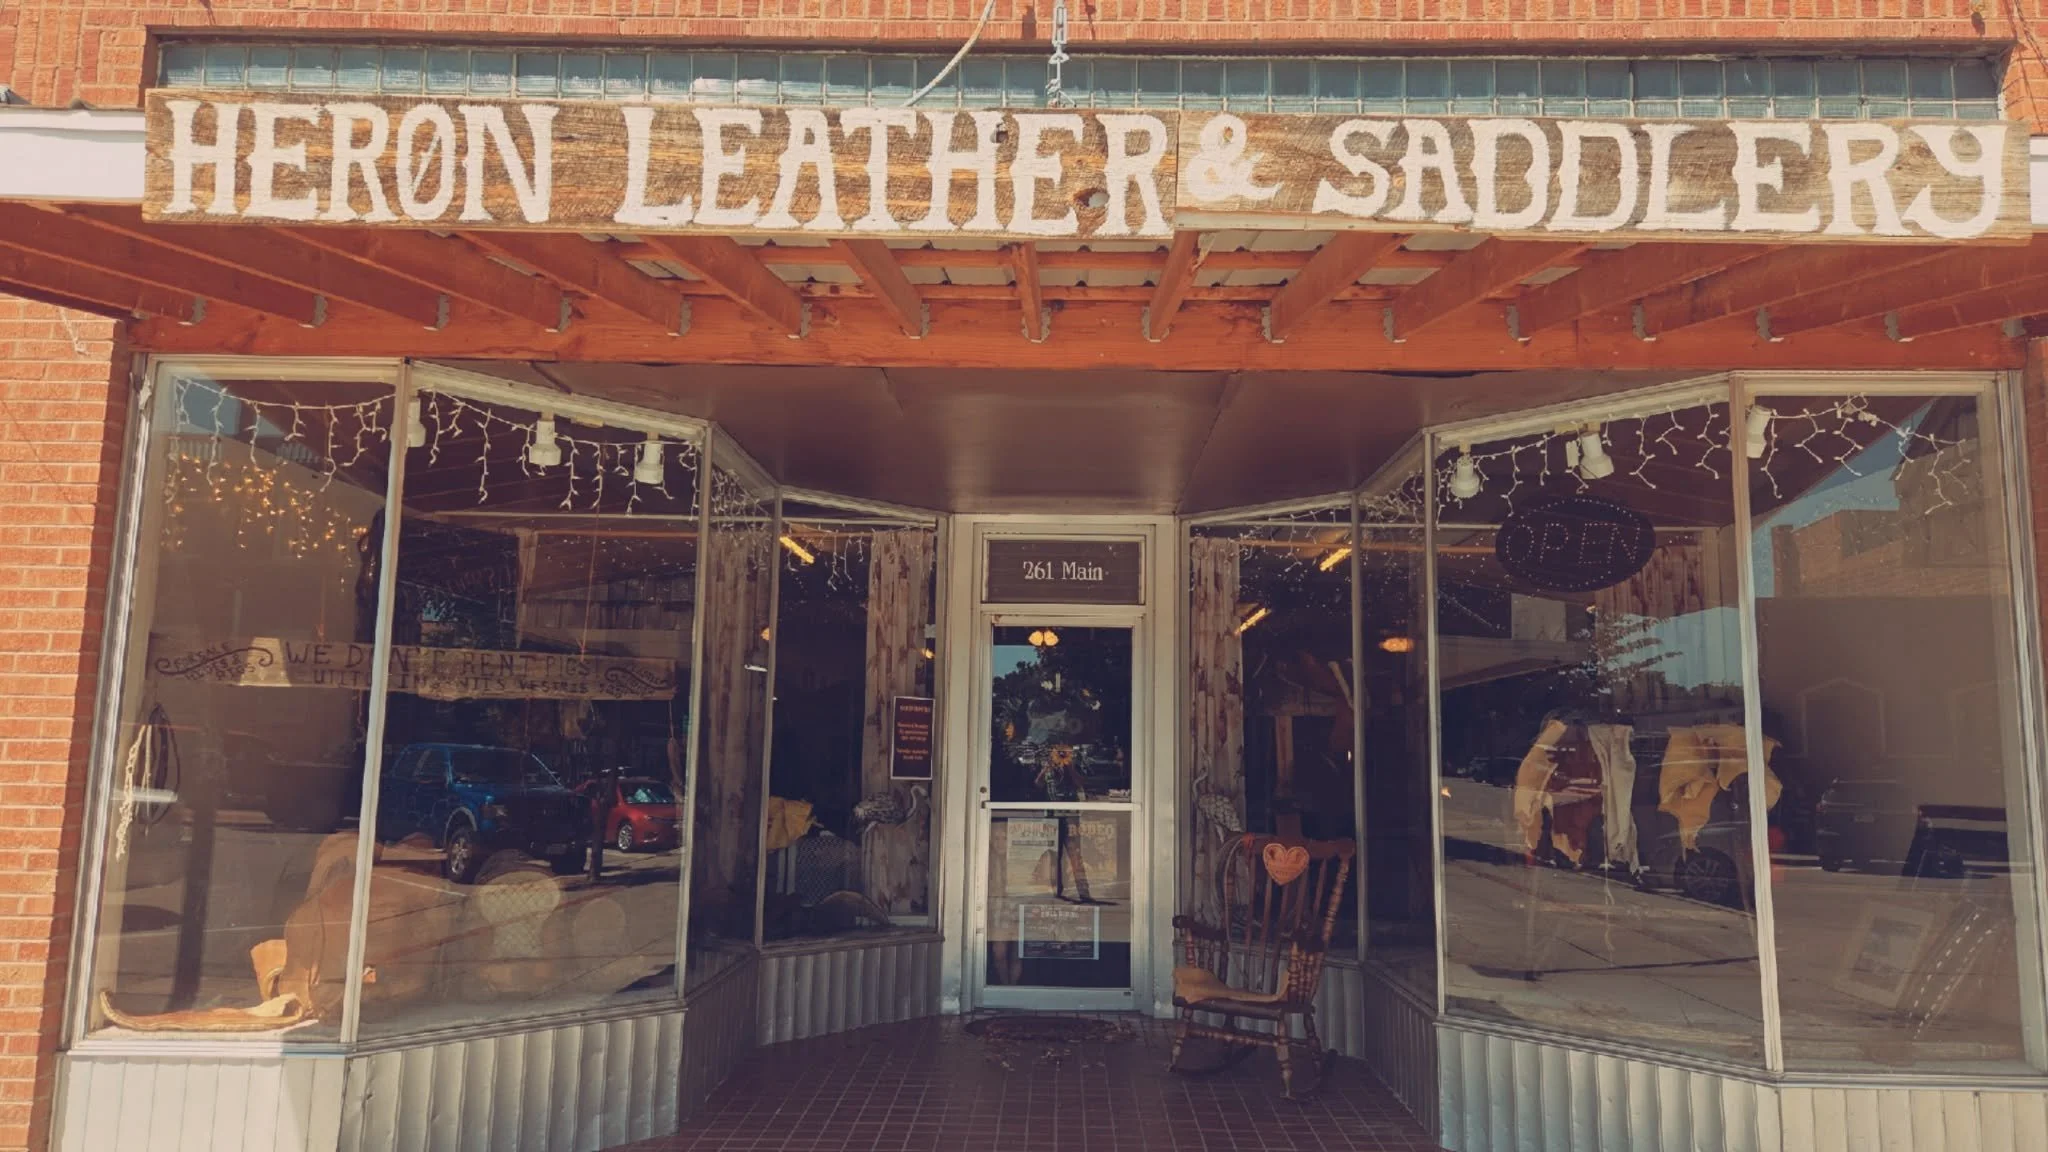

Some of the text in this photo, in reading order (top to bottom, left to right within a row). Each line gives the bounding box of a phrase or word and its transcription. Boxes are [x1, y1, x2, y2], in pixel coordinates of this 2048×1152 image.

[613, 106, 1174, 237] LEATHER
[1186, 113, 1288, 204] &
[1313, 117, 2008, 240] SADDLERY
[1505, 522, 1641, 564] OPEN
[1023, 561, 1104, 581] 261 Main
[286, 641, 333, 665] WE
[344, 644, 446, 675] DN'T
[461, 651, 537, 678] RENT
[1067, 822, 1117, 839] RODEO
